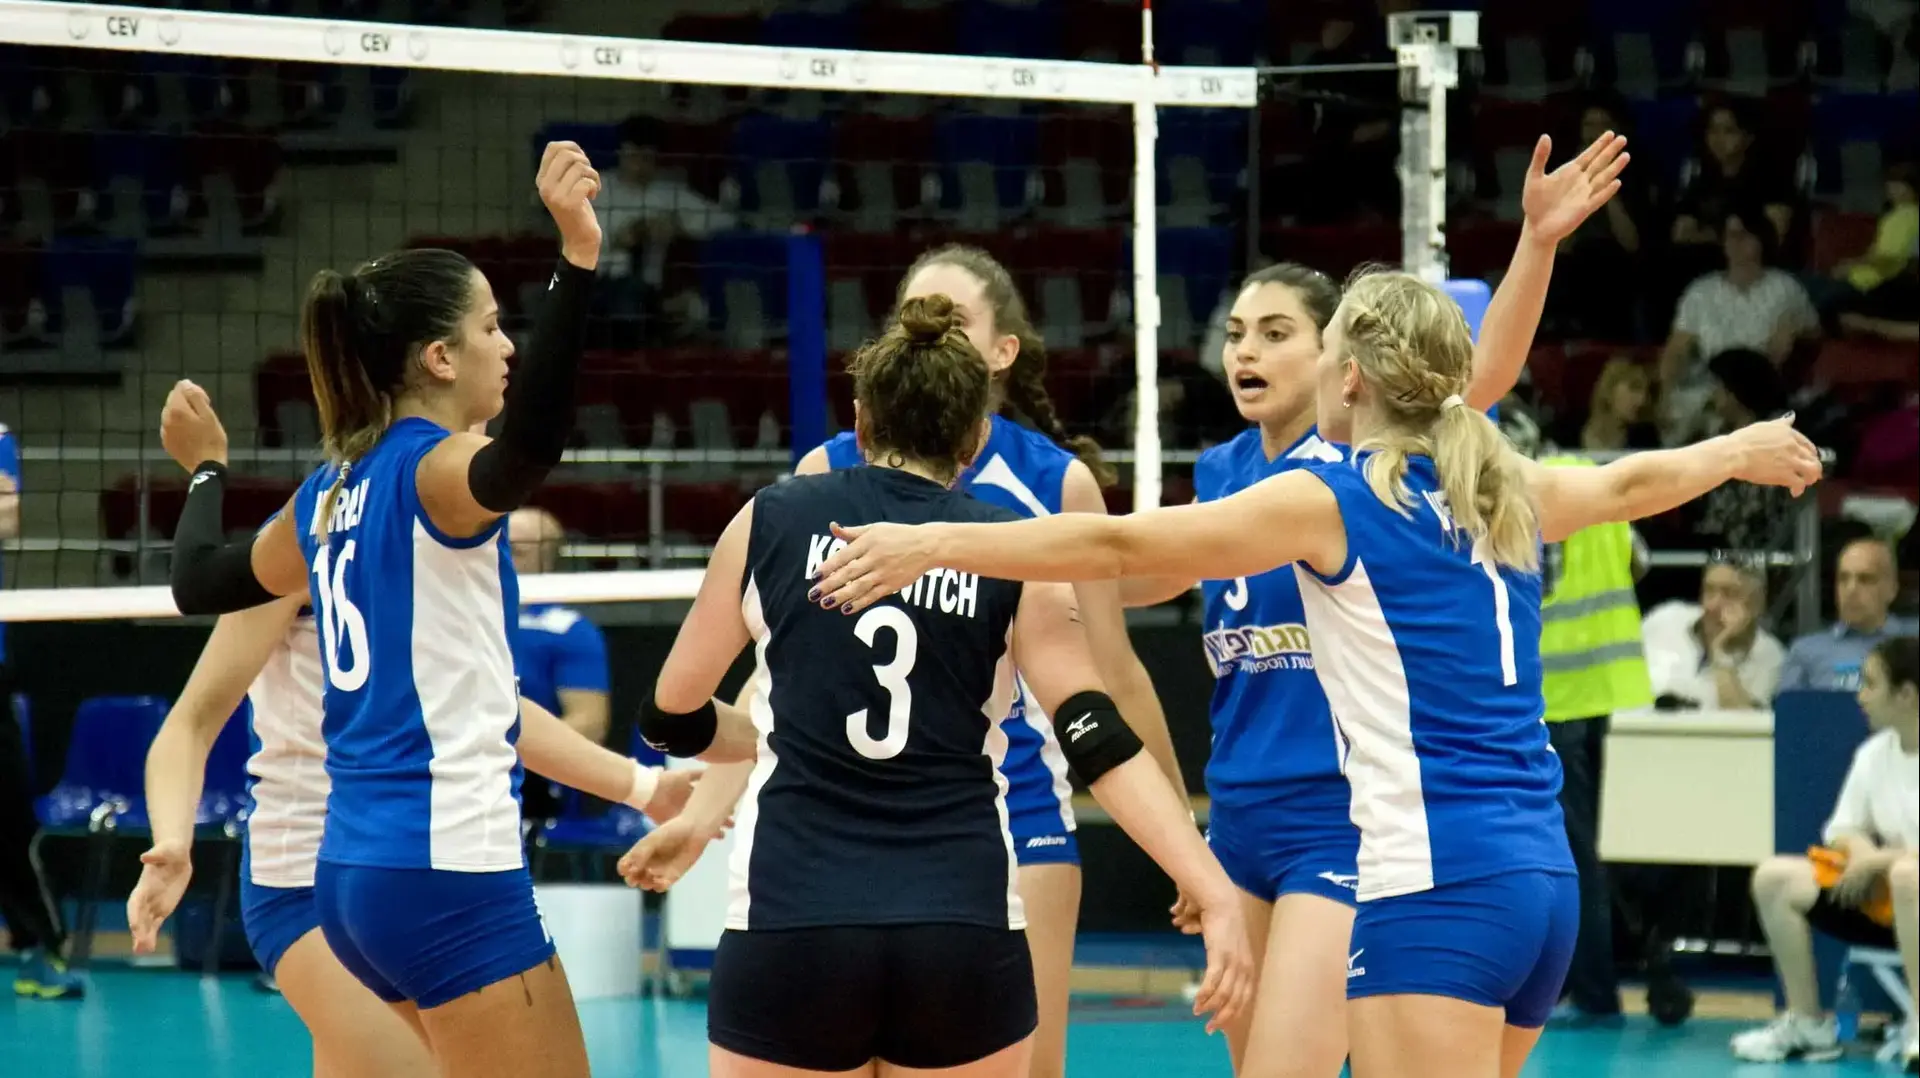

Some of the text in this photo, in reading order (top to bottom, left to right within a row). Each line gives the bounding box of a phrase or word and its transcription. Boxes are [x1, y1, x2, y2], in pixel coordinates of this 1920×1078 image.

[106, 16, 141, 36] CEV
[360, 32, 392, 52] CEV
[594, 46, 622, 65] CEV
[313, 539, 370, 692] 16
[846, 605, 918, 760] 3
